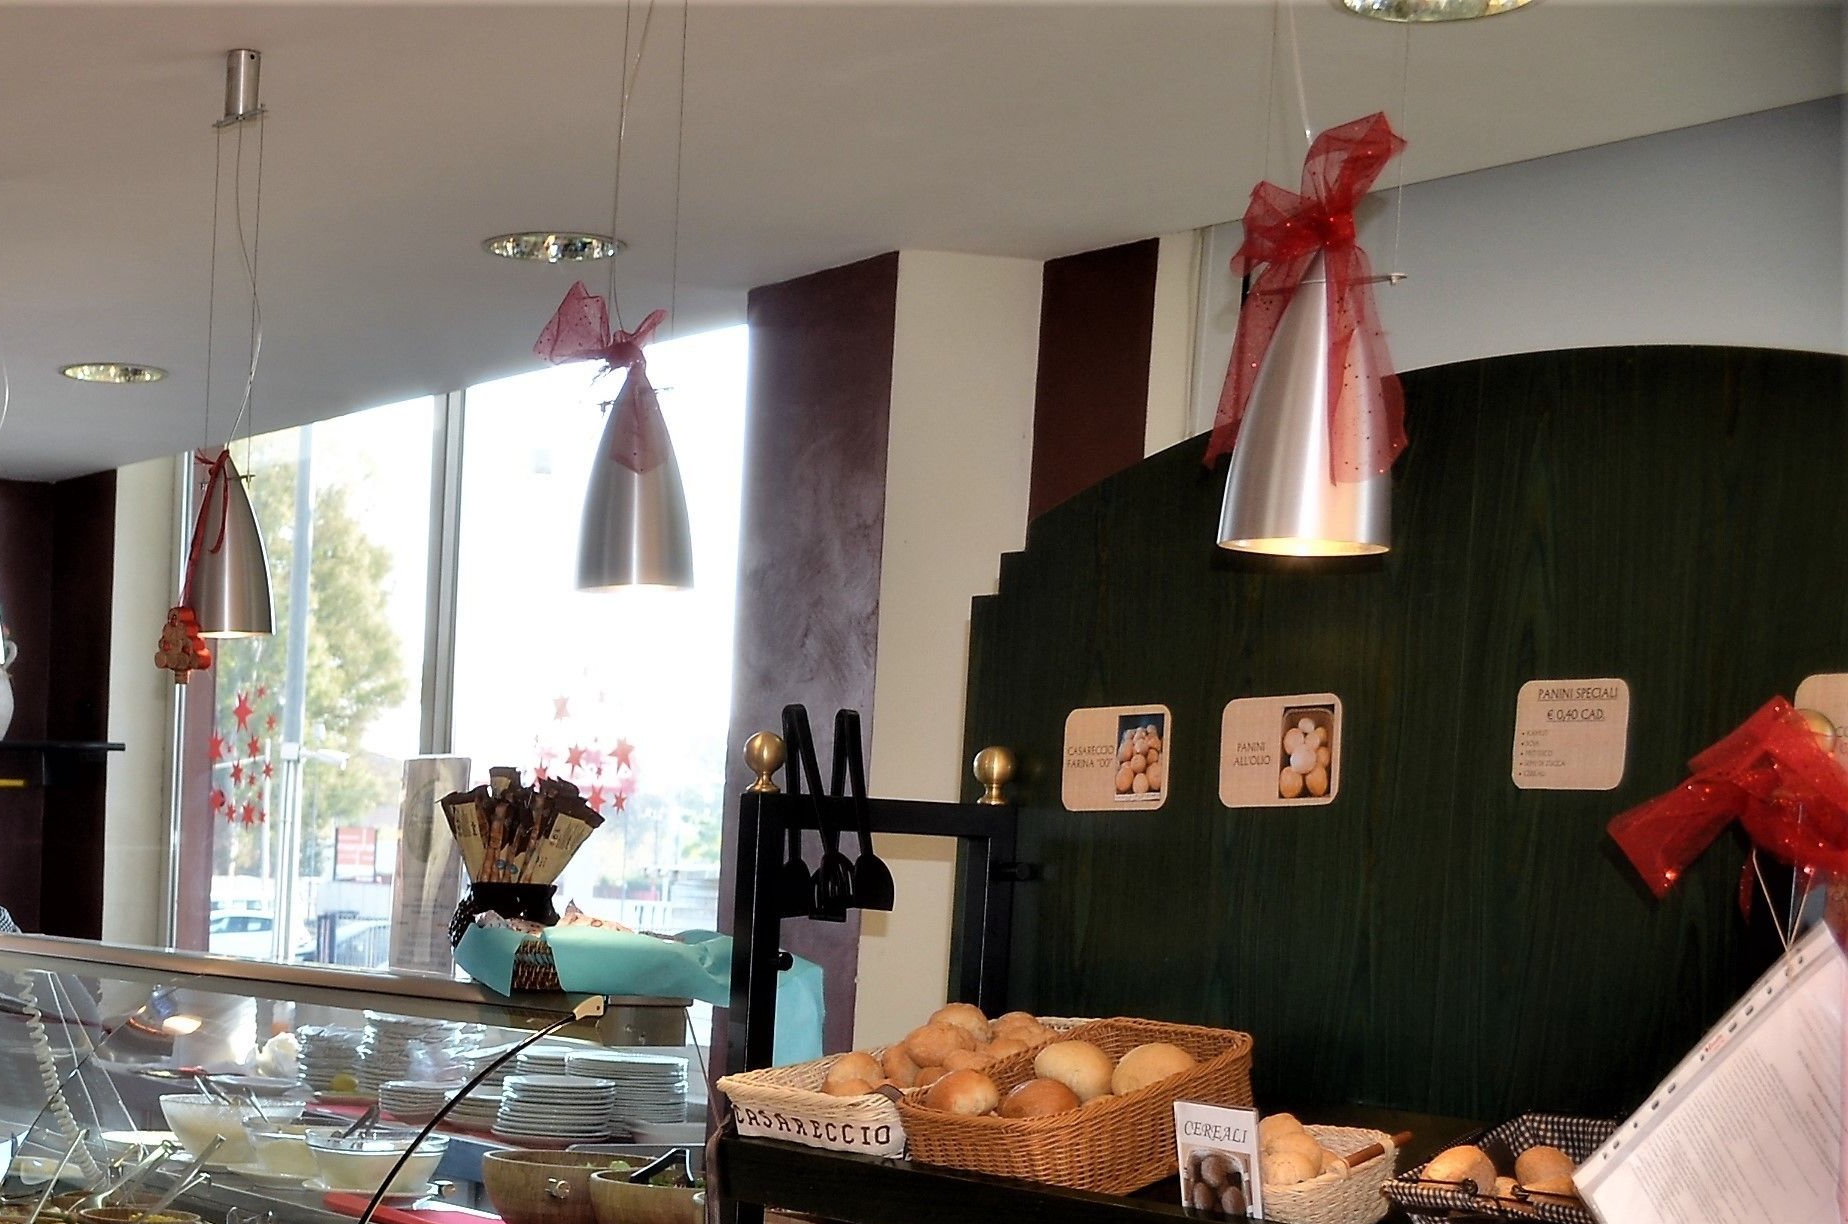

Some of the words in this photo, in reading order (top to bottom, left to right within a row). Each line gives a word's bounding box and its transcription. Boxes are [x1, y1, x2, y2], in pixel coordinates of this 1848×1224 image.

[1538, 688, 1573, 700] PANINI
[1576, 687, 1618, 699] SPECIALI
[1547, 709, 1554, 720] €
[1556, 708, 1578, 721] 0,40
[1237, 742, 1265, 752] PANINI
[1067, 758, 1095, 768] FARINA
[732, 1104, 891, 1146] CASARECCIO
[1184, 1120, 1248, 1143] CEREALI
